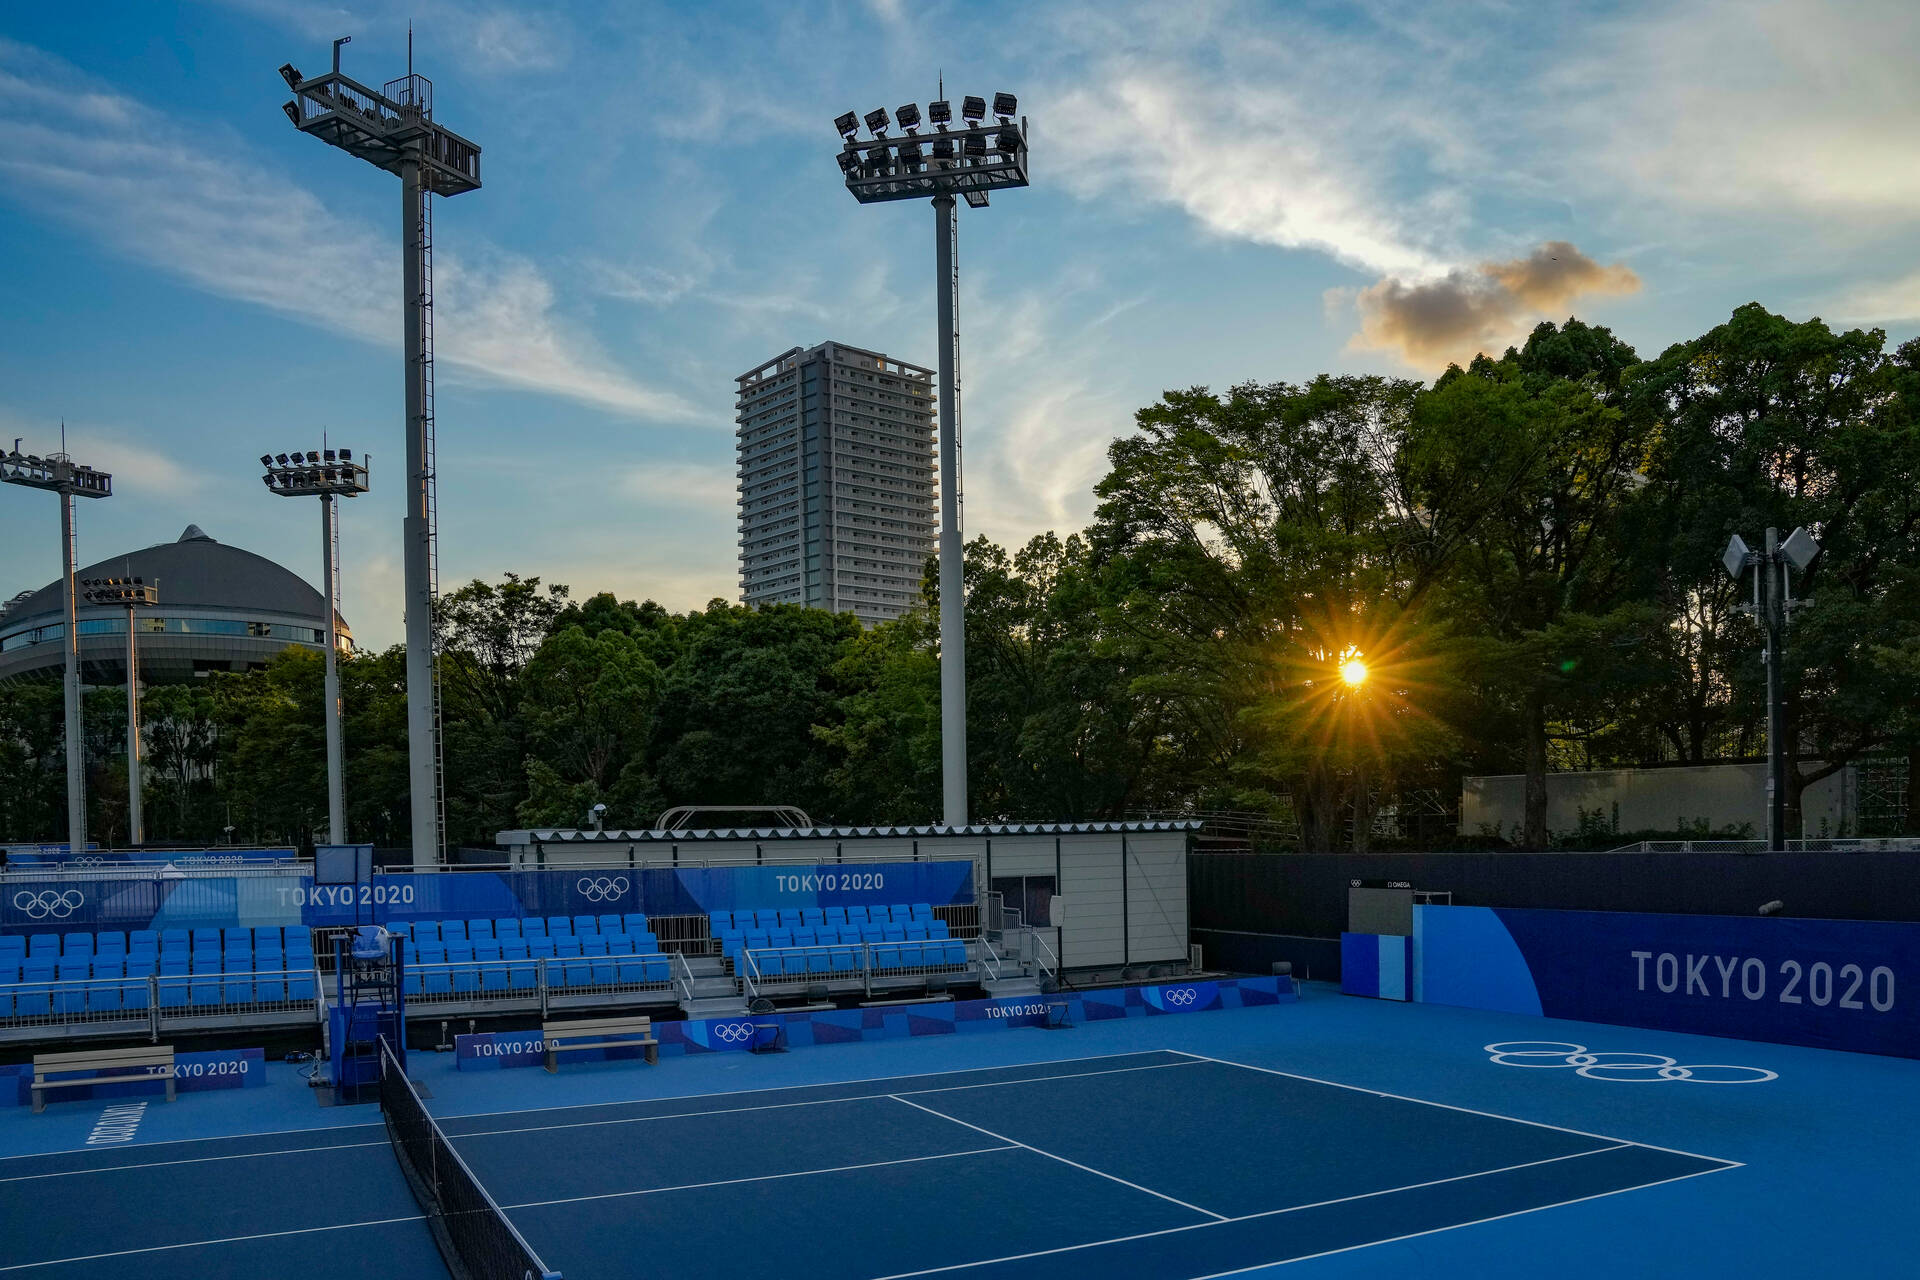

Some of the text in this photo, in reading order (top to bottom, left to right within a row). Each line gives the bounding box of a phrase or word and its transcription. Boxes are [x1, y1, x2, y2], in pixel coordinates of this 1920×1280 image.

[183, 855, 244, 865] TOKYO 2020
[776, 873, 884, 893] TOKYO 2020
[276, 885, 415, 907] TOKYO 2020
[1631, 950, 1895, 1012] TOKYO 2020
[984, 1005, 1023, 1019] TOKYO
[473, 1041, 522, 1057] TOKYO
[207, 1060, 249, 1076] 2020
[85, 1101, 148, 1145] TOKYO 2020
